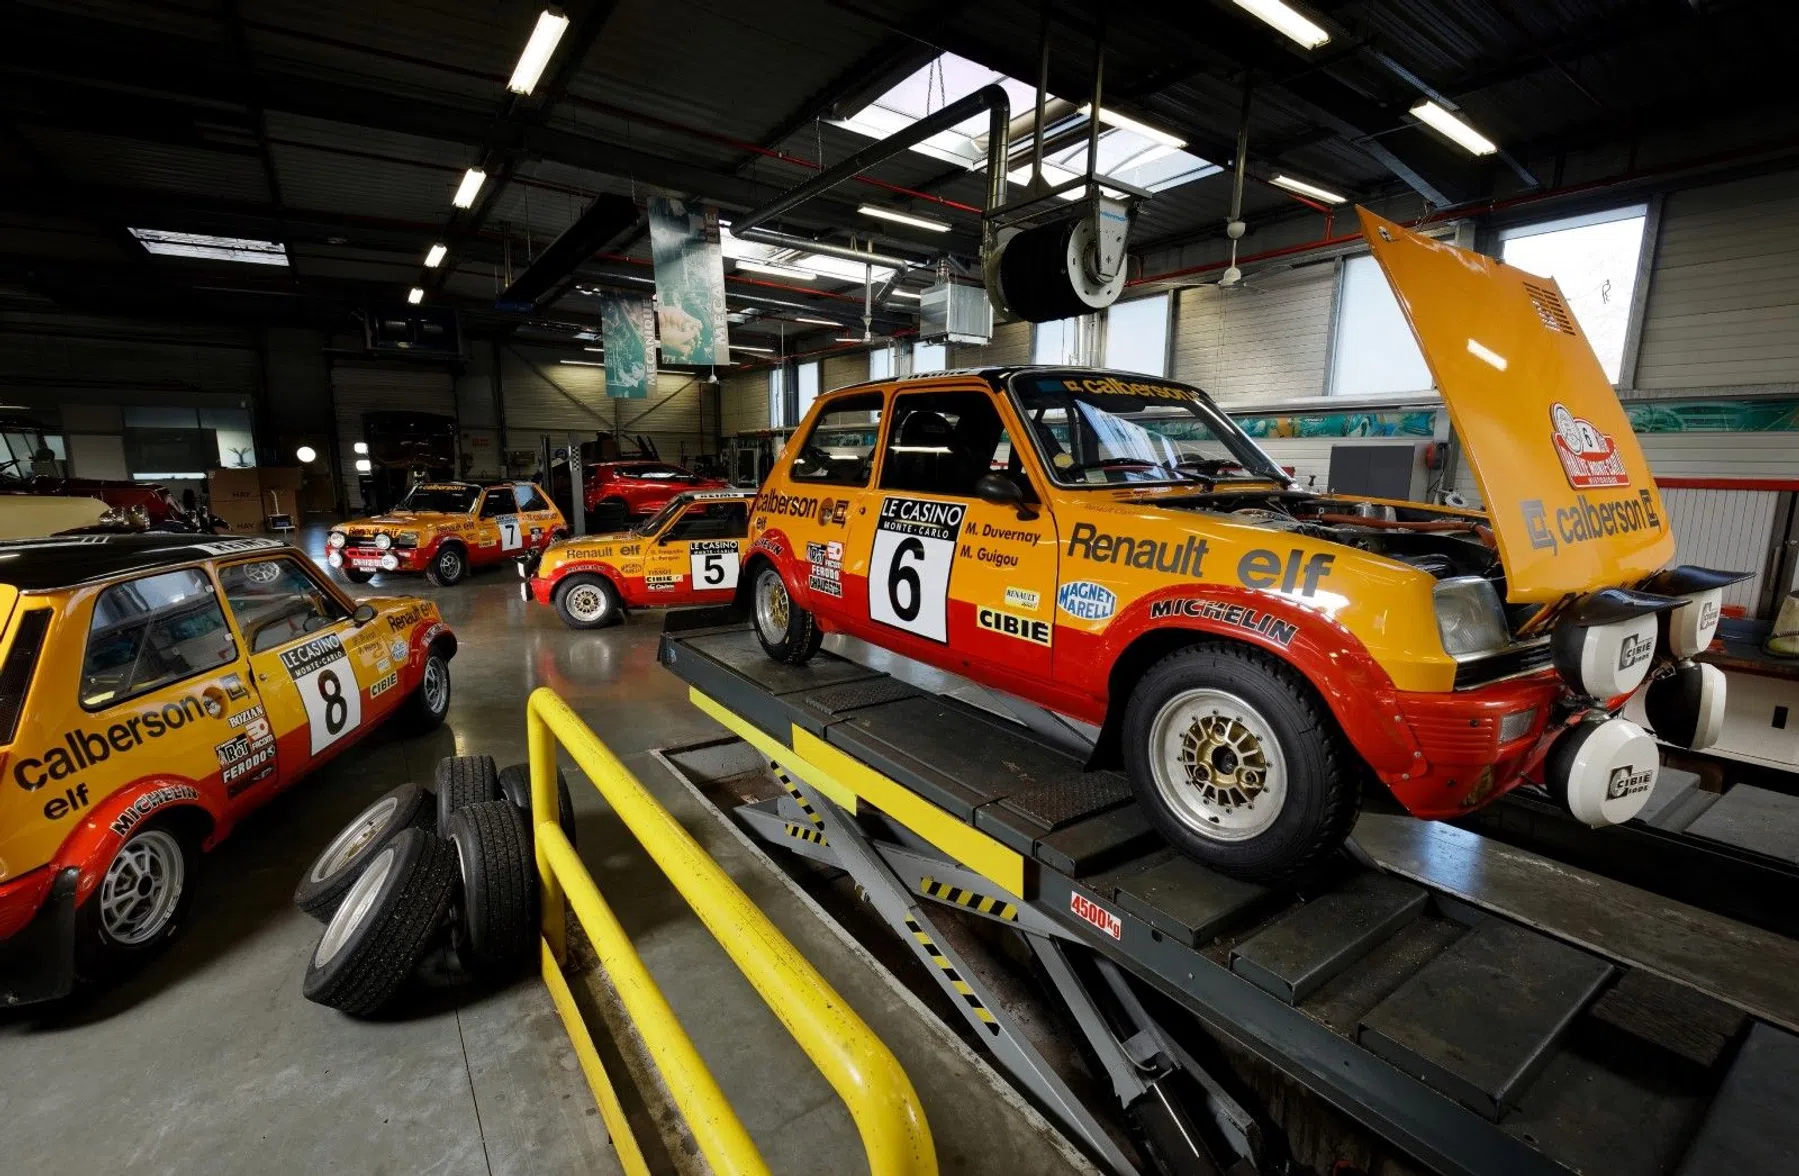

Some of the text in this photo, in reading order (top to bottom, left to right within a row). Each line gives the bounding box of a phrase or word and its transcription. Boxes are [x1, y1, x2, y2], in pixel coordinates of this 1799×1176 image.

[1082, 378, 1191, 400] calberson
[1582, 427, 1593, 448] 6
[757, 489, 817, 519] calberson
[882, 500, 962, 526] LE CASINO
[1555, 495, 1648, 544] calberson
[505, 524, 514, 545] 7
[702, 541, 738, 549] CASINO
[965, 521, 1041, 547] M. Duvernay
[567, 547, 612, 559] Renault
[620, 545, 640, 555] elf
[960, 545, 1018, 567] M. Guigou
[1067, 522, 1336, 598] Renault elf
[704, 555, 724, 584] 5
[811, 565, 839, 580] FERODO
[888, 537, 925, 622] 6
[1059, 583, 1116, 605] MAGNETI
[1067, 599, 1115, 618] MARELLI
[1151, 598, 1299, 645] MICHELIN
[282, 651, 300, 668] LE
[297, 635, 340, 662] CASINO
[318, 669, 347, 735] 8
[14, 695, 204, 791] calberson
[223, 750, 266, 783] FERODO
[1617, 774, 1652, 788] CIBIE
[43, 782, 90, 820] elf
[109, 786, 199, 837] MICHELIN
